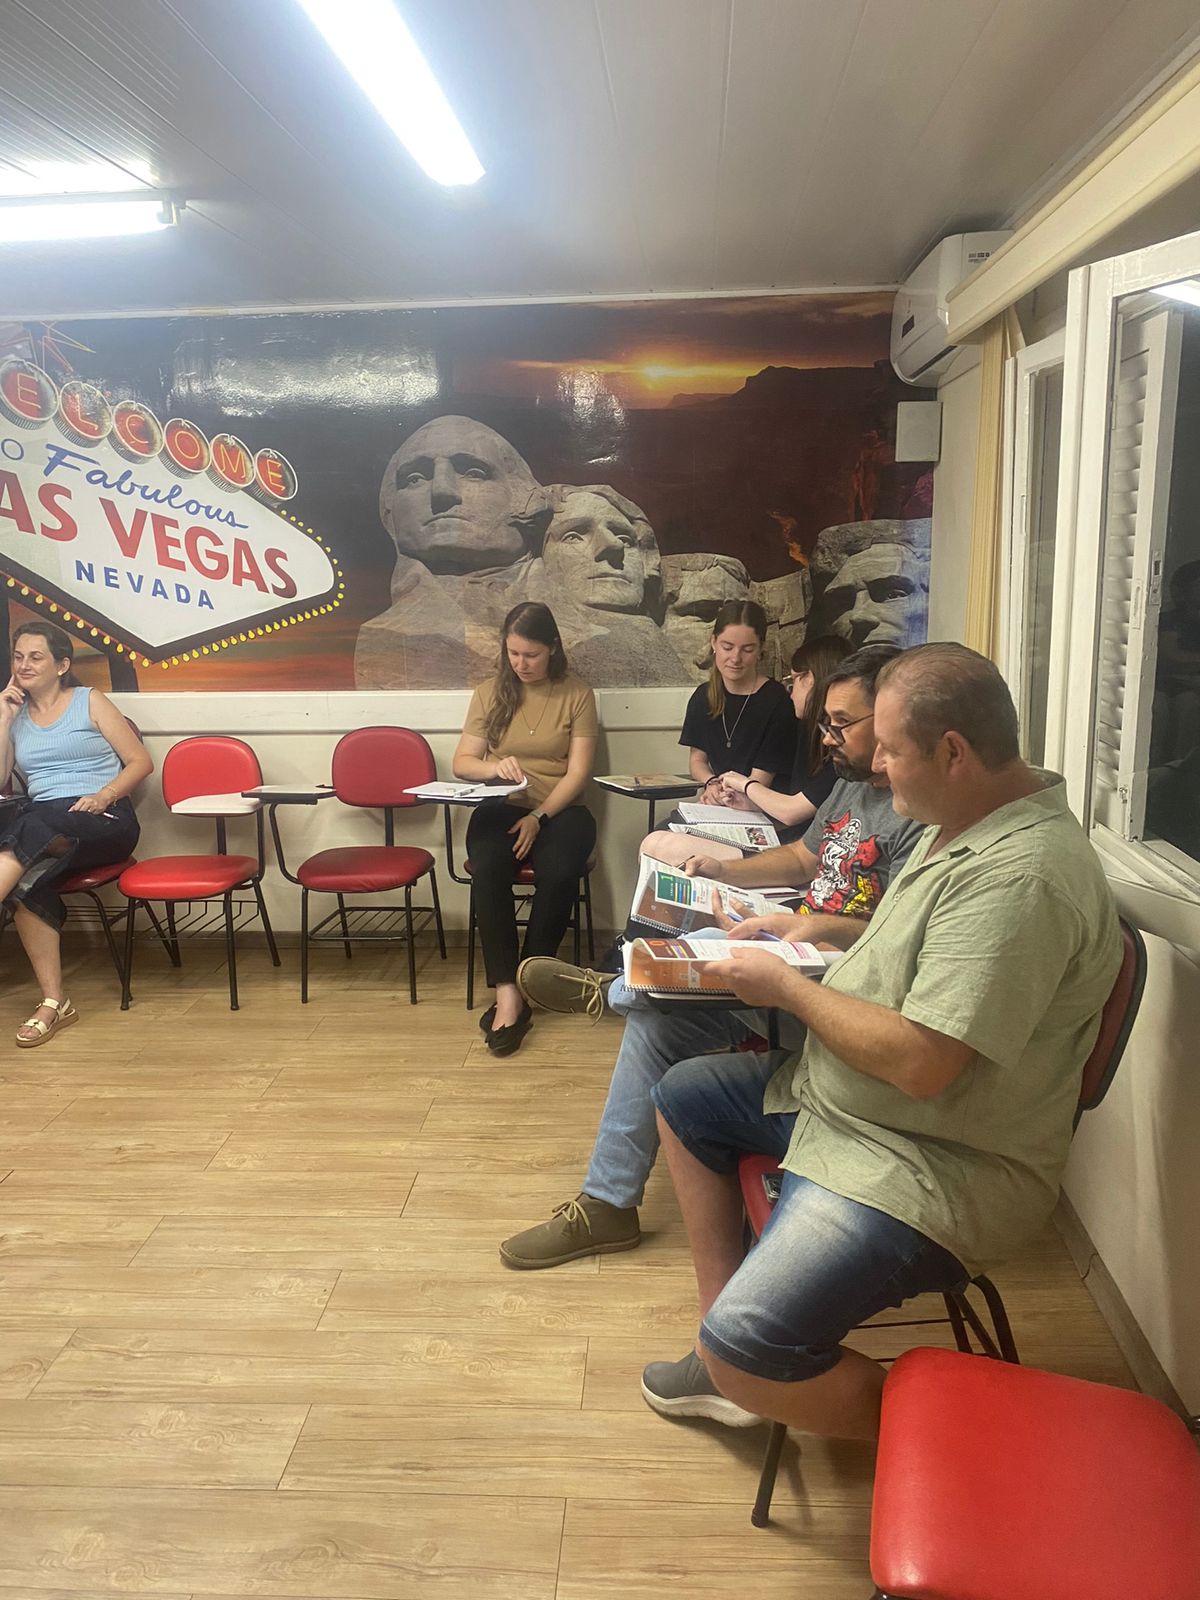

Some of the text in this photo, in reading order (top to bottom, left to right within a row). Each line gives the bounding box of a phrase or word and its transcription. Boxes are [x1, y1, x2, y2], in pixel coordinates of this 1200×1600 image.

[15, 371, 287, 492] ELCOME
[0, 469, 298, 599] AS VEGAS
[44, 443, 249, 529] Fabulous
[75, 560, 215, 610] NEVADA
